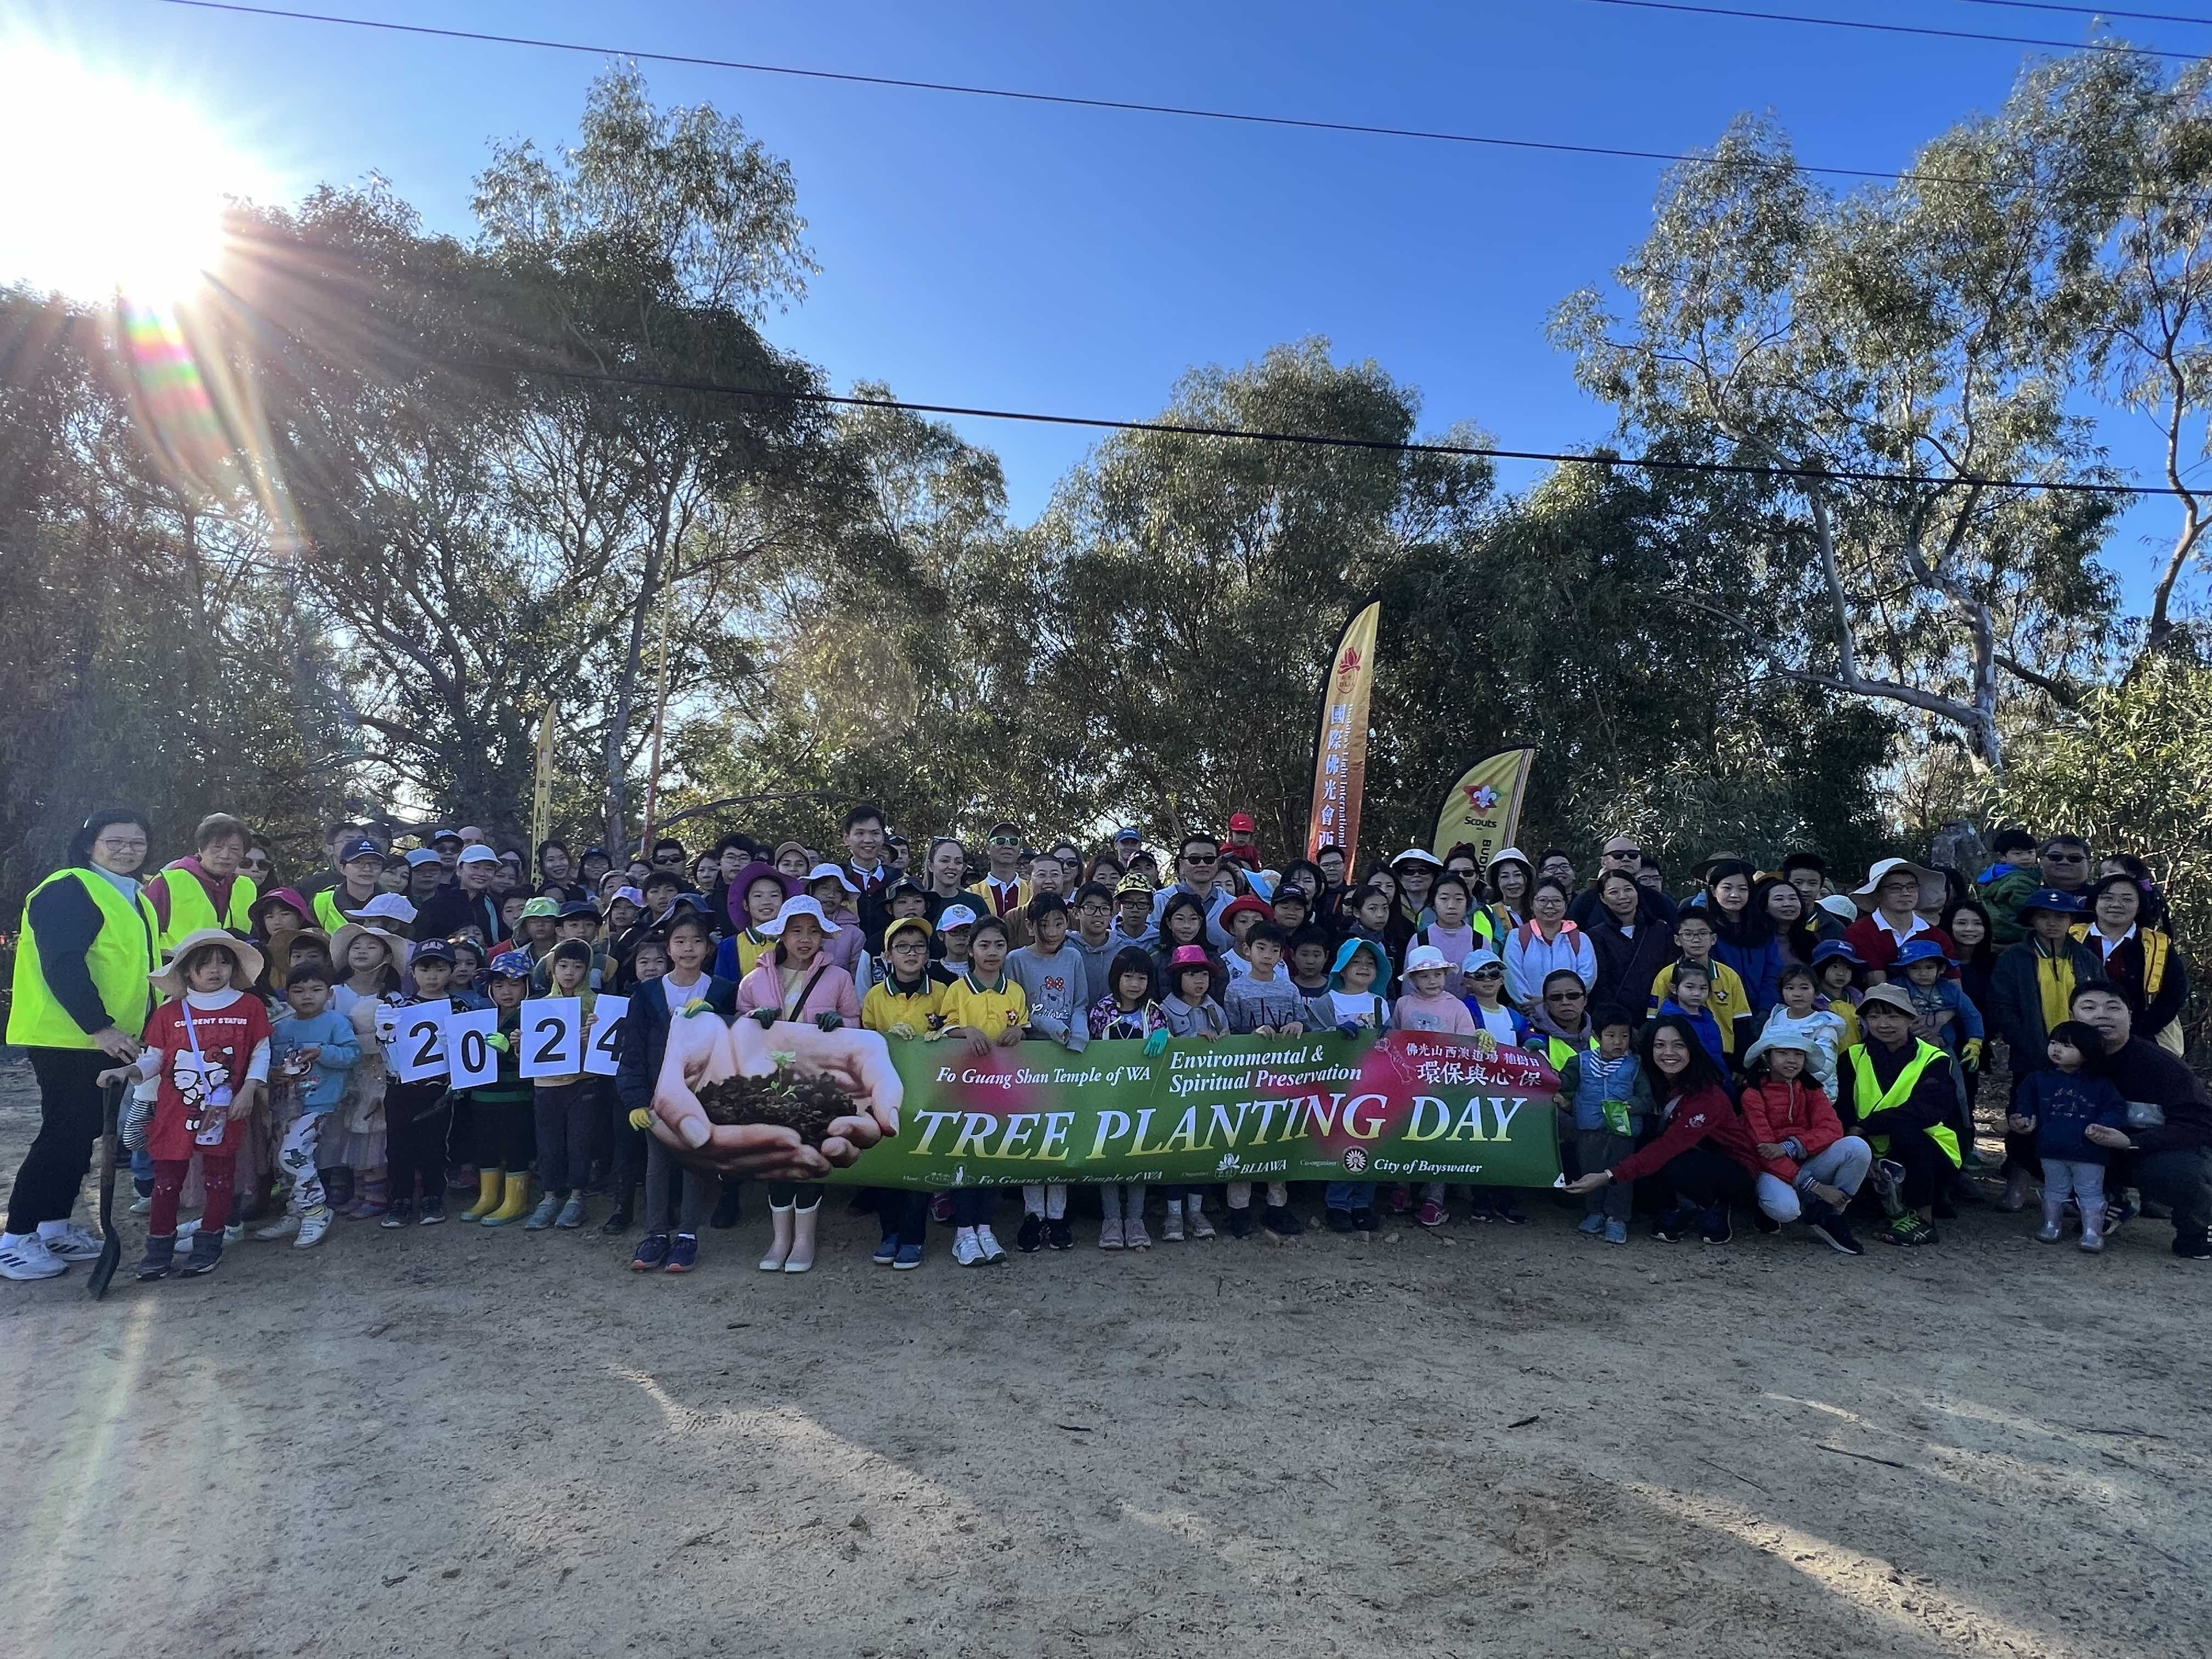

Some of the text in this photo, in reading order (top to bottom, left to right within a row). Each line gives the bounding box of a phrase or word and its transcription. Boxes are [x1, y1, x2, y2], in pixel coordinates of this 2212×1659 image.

[1339, 782, 1348, 848] International
[1464, 816, 1497, 828] Scouts
[174, 1018, 216, 1028] CURENT
[1170, 1045, 1323, 1069] Environmental &
[936, 1066, 1150, 1090] Fo Guang Shan Temple of WA
[1169, 1063, 1362, 1097] Spiritual Preservation
[909, 1093, 1528, 1161] TREE PLANTING DAY
[979, 1175, 994, 1184] Fo
[1126, 1171, 1143, 1182] of
[1374, 1159, 1482, 1175] City of Bayswater
